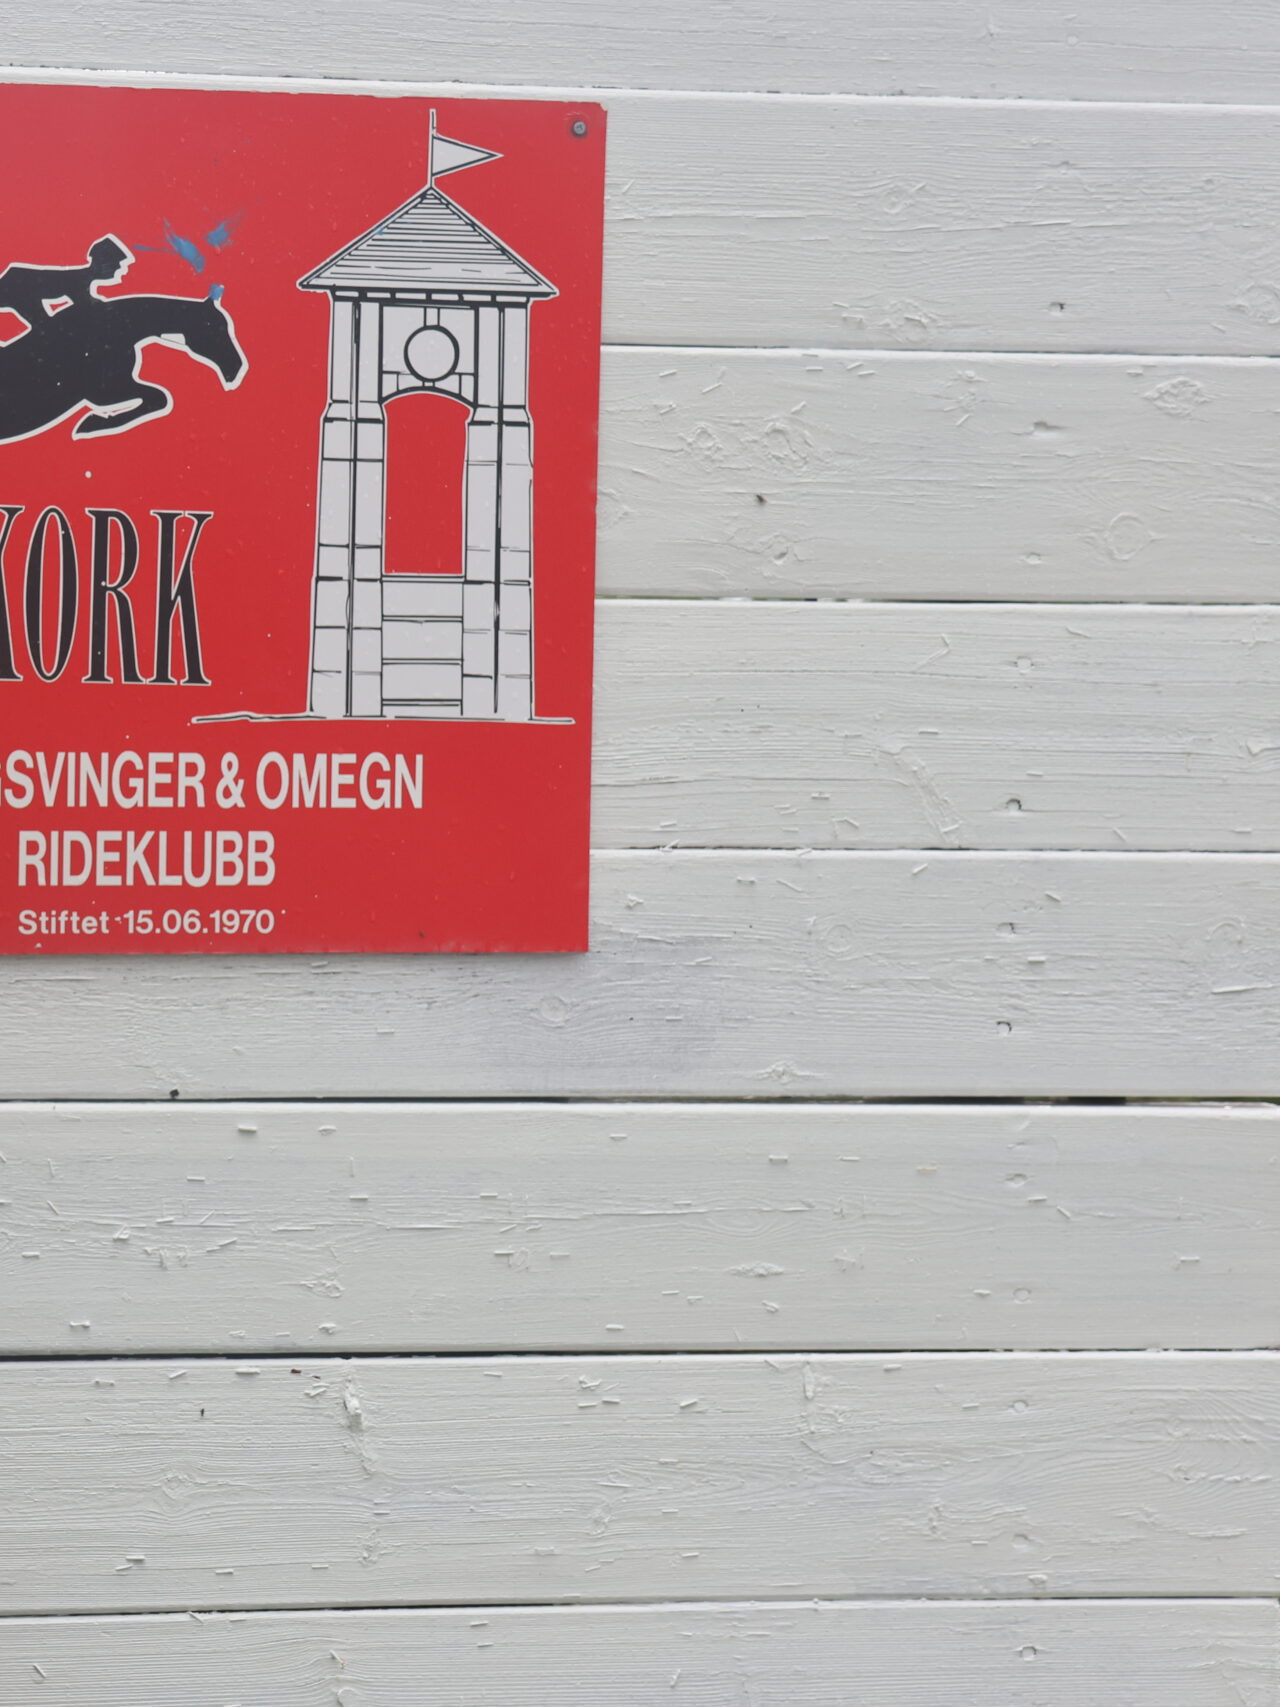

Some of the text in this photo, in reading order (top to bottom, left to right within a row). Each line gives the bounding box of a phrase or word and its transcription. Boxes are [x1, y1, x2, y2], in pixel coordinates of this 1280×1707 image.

[215, 751, 246, 809] &
[255, 751, 424, 810] OMEGN
[18, 830, 276, 888] RIDEKLUBB
[18, 909, 275, 935] Stiftet 15.06.1970
